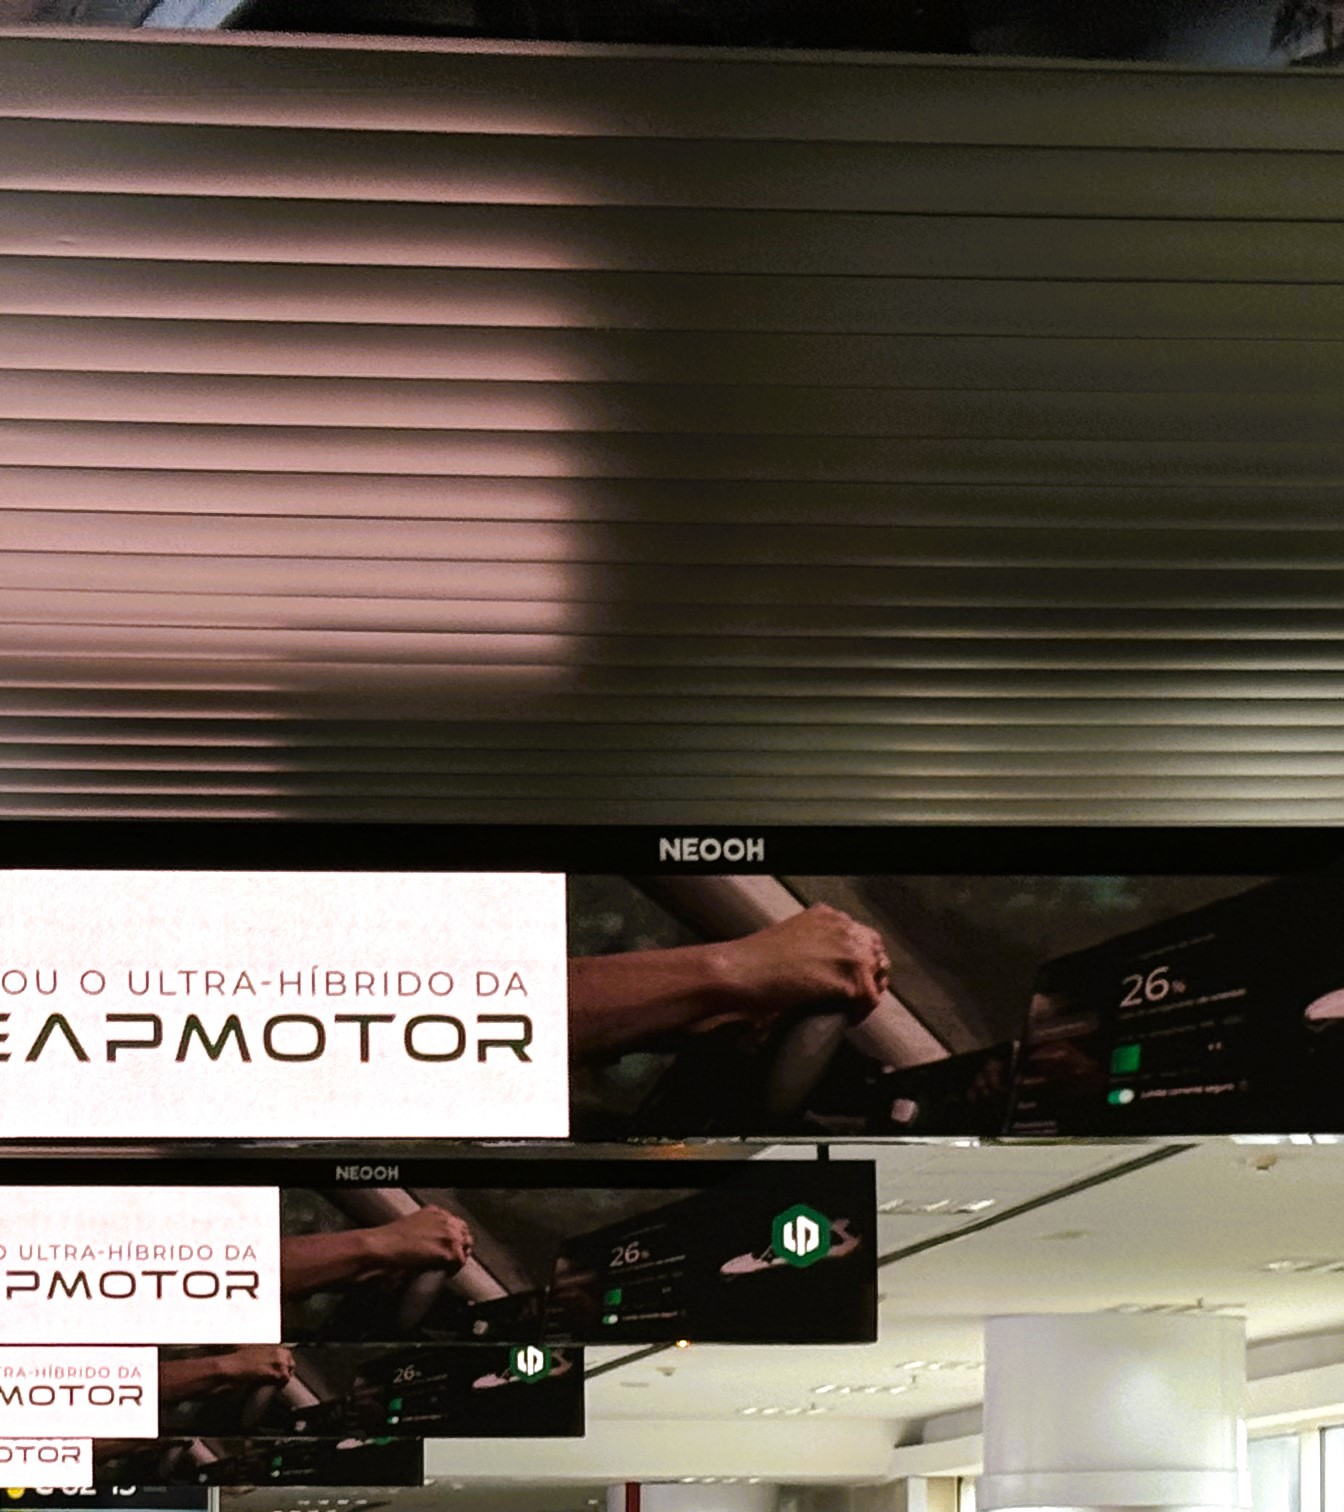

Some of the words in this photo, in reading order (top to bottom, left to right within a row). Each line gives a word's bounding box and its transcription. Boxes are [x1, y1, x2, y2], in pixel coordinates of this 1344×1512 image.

[659, 838, 764, 861] NEOOH
[79, 968, 107, 996] O
[128, 965, 455, 997] ULTRA-HÍBRIDO
[475, 970, 529, 997] DA
[336, 1166, 399, 1181] NEOOH
[19, 1241, 214, 1262] ULTRA-HÍBRIDO
[225, 1243, 257, 1261] DA
[117, 1365, 142, 1379] DA
